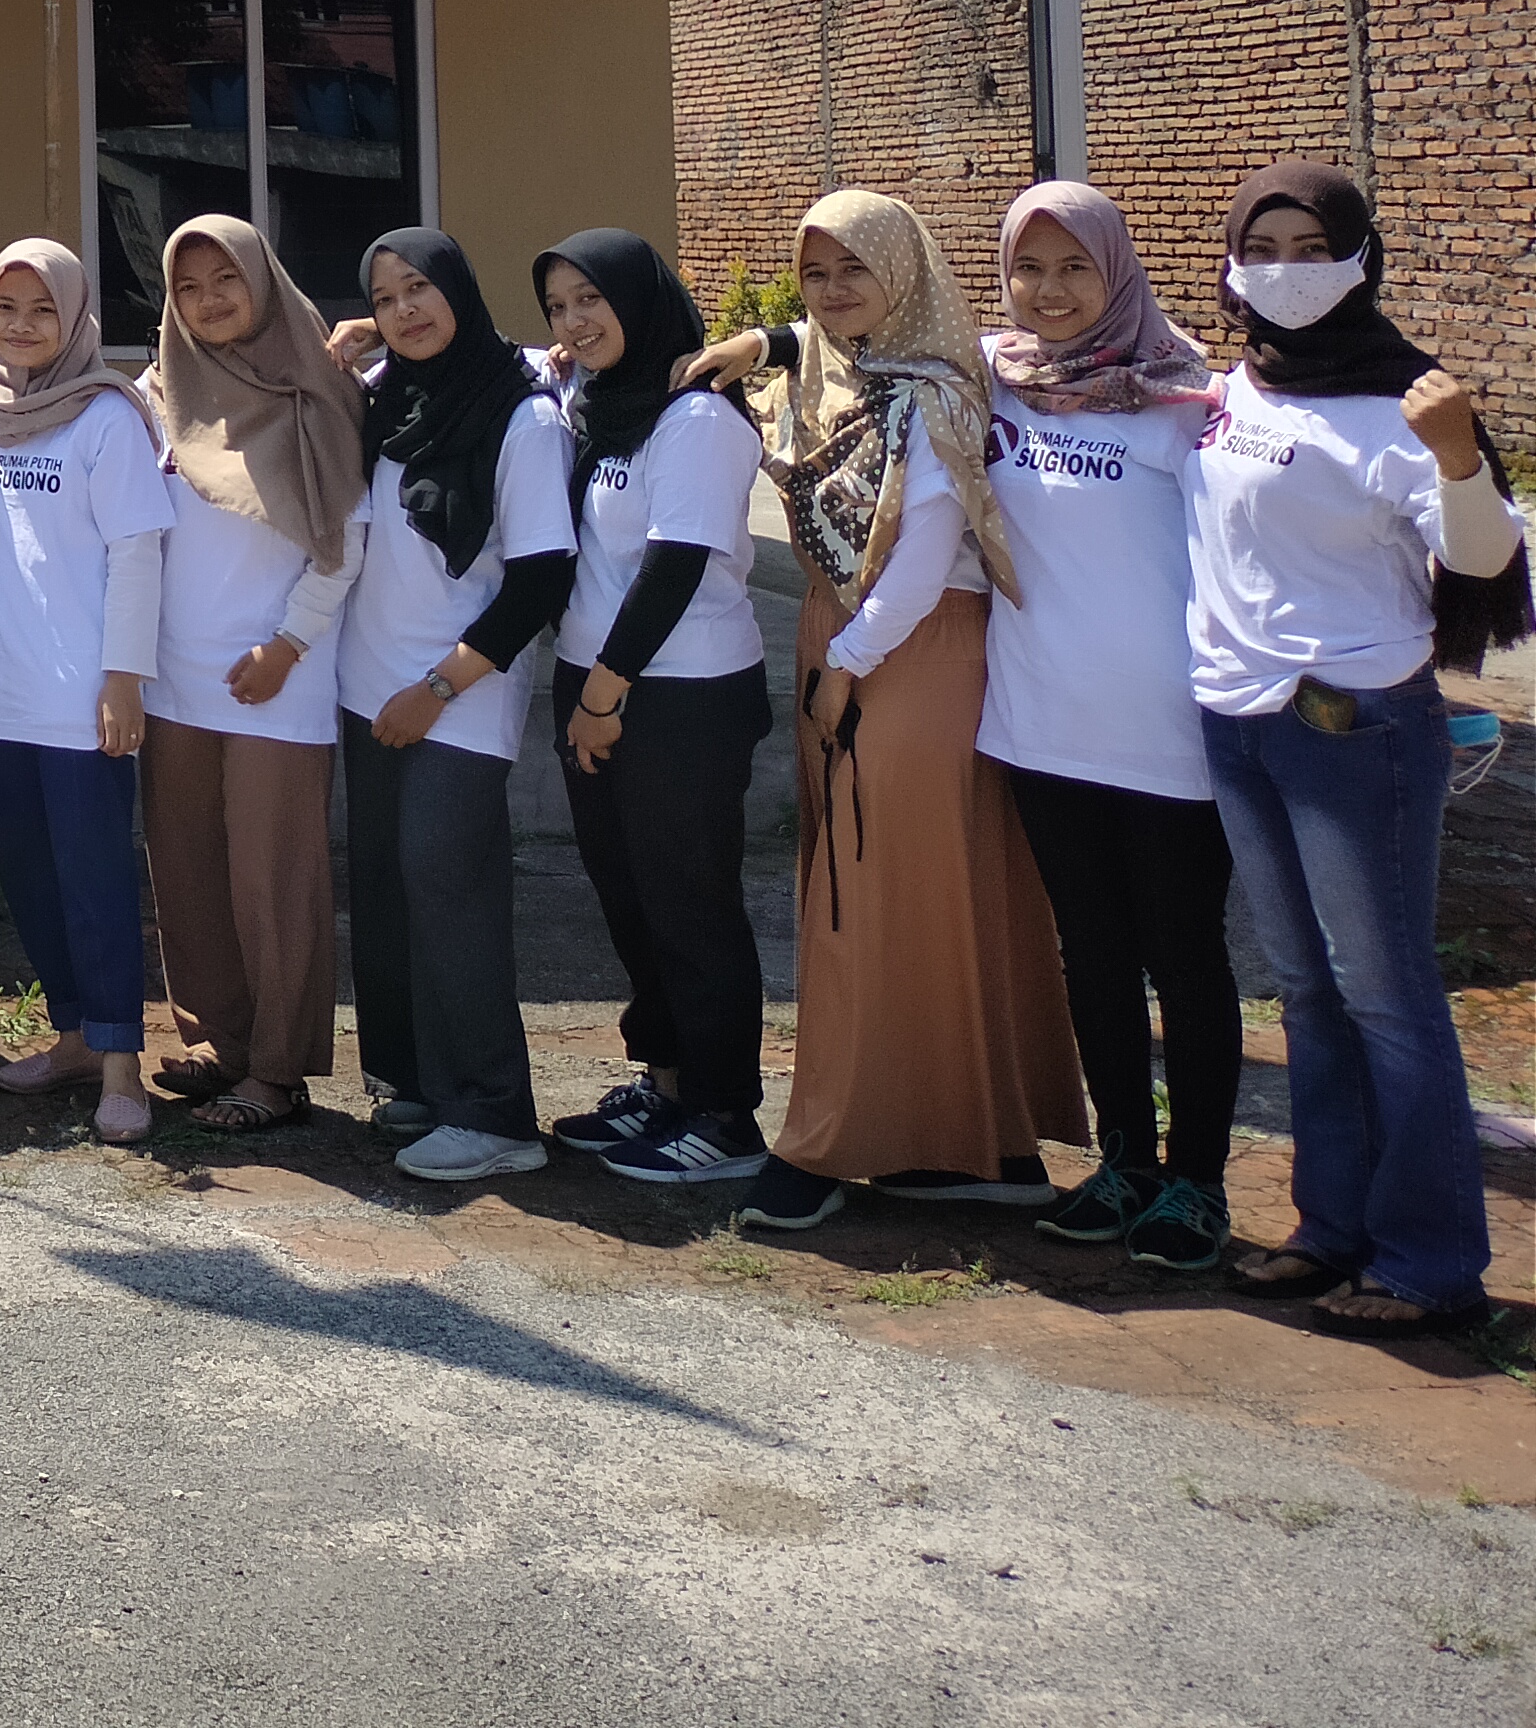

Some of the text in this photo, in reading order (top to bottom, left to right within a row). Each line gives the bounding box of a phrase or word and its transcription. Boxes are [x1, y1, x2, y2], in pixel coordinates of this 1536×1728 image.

[1076, 439, 1127, 458] PUTIH
[1221, 435, 1295, 466] SUGIONO
[30, 456, 62, 472] PUTIH
[1015, 447, 1123, 481] SUGIONO
